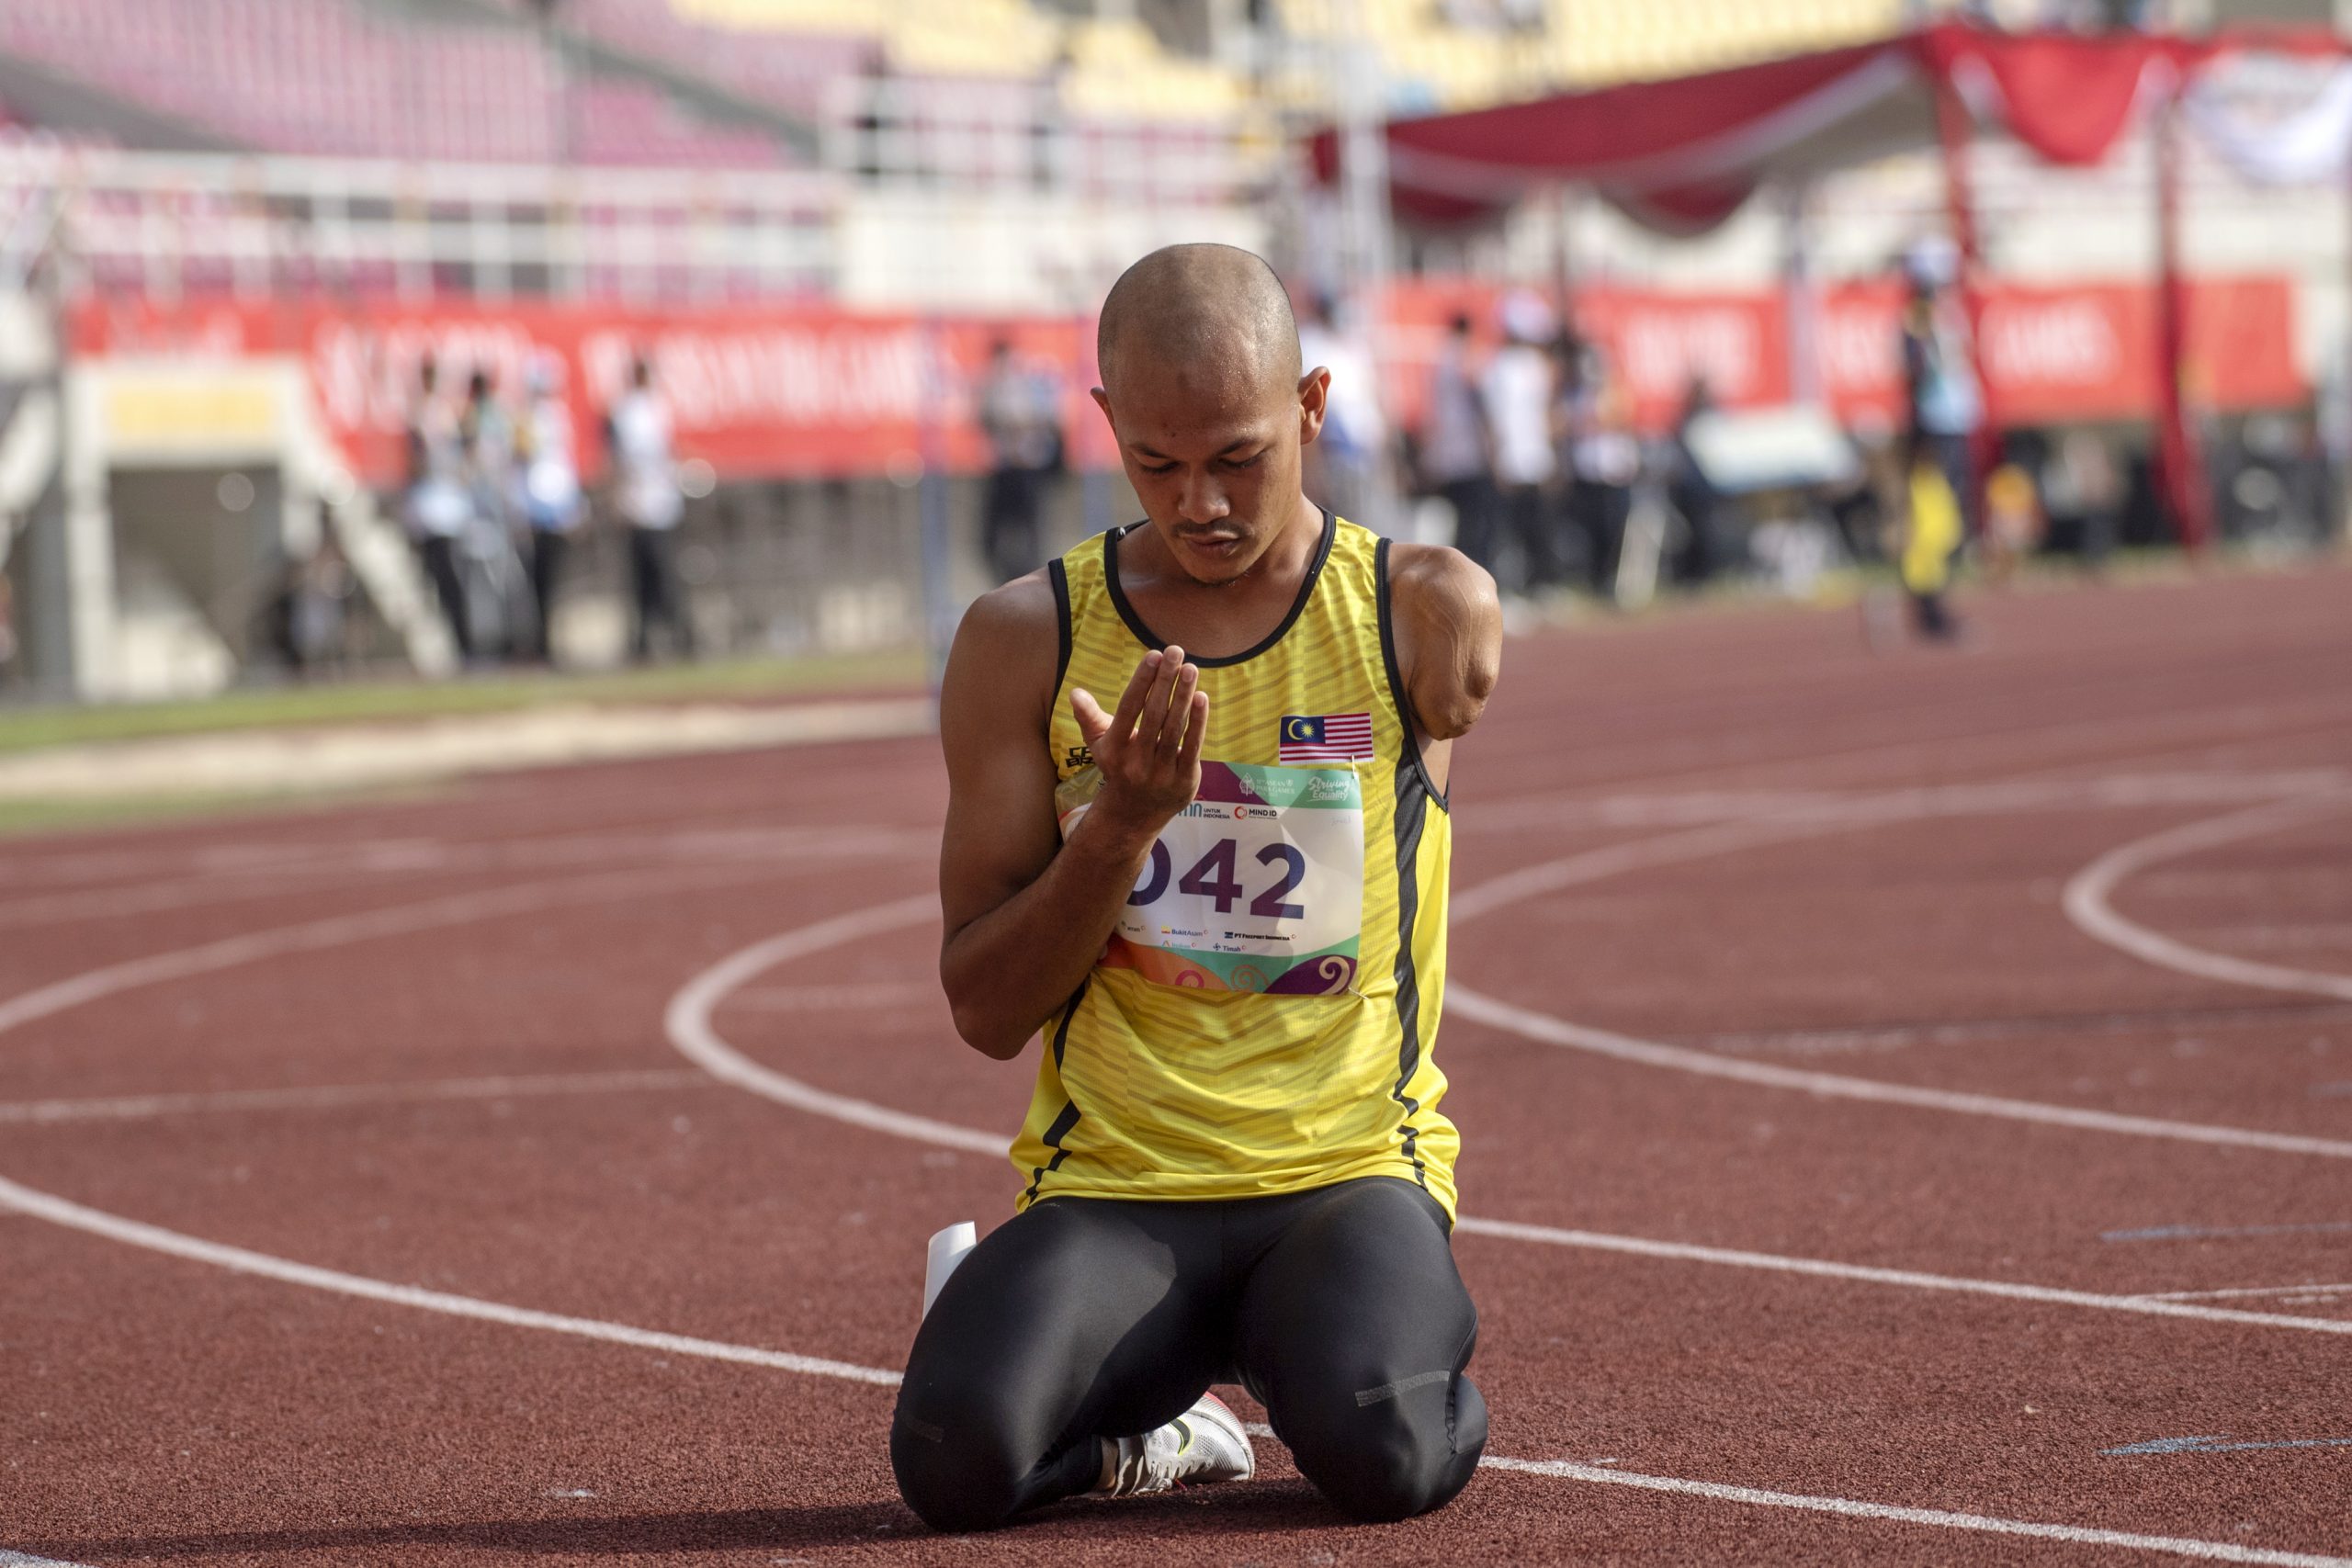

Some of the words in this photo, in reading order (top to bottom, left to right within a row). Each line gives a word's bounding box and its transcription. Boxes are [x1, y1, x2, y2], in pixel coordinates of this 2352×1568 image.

[1308, 776, 1351, 793] Striving
[1312, 790, 1348, 801] Equality
[1171, 928, 1204, 937] BukitAsam
